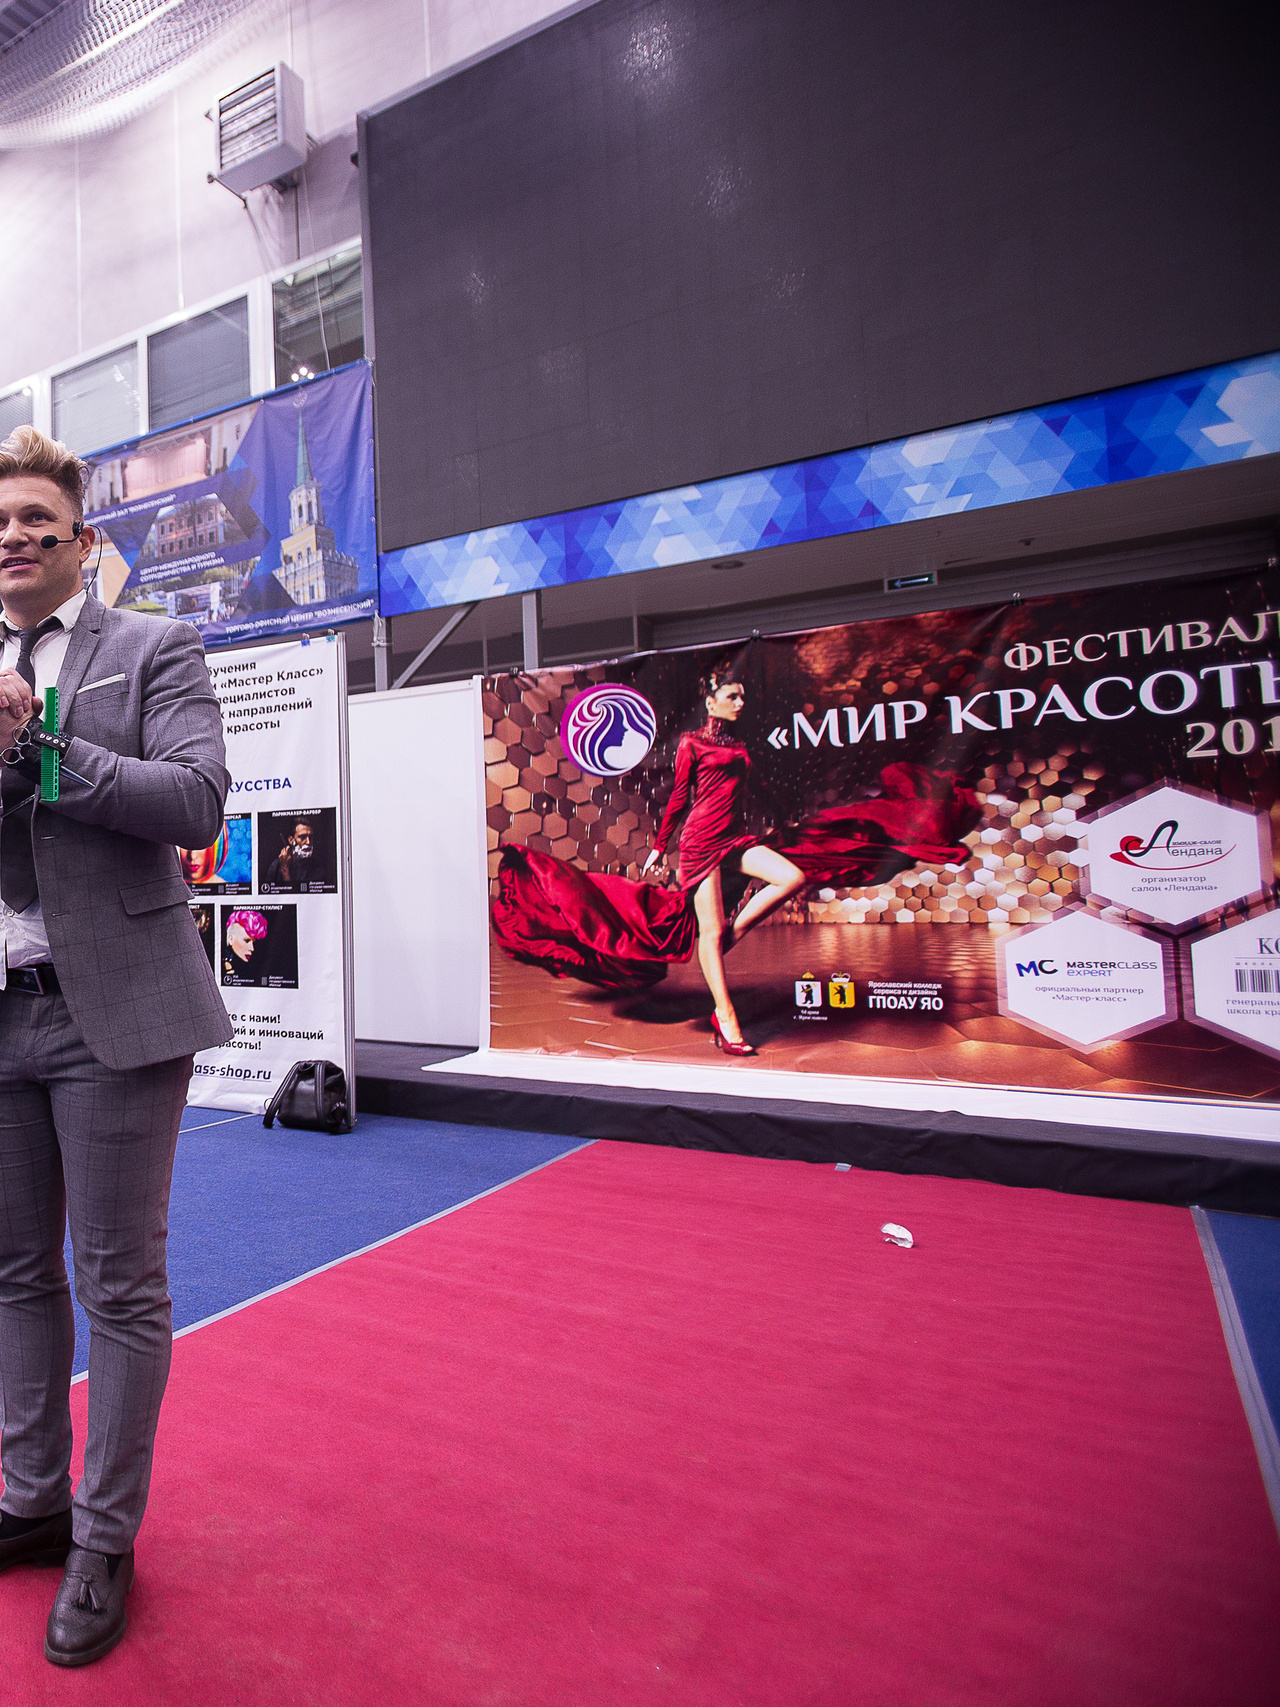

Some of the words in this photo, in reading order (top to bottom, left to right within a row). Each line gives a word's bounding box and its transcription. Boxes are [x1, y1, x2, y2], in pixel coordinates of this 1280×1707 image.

[290, 611, 314, 624] ЦЕНТР
[1004, 610, 1280, 671] ФЕСТИВАЛ
[221, 675, 273, 689] «Мастер
[277, 667, 323, 681] Класс»
[228, 697, 313, 719] направлений
[227, 719, 281, 735] красоты
[767, 700, 927, 750] «МИР
[1186, 716, 1280, 758] 201
[1141, 876, 1207, 884] организатор
[1164, 884, 1218, 892] «Лендана»
[1103, 987, 1144, 995] партнер
[868, 995, 917, 1010] ГПОАУ
[920, 997, 944, 1011] ЯО
[240, 1014, 246, 1022] с
[249, 1014, 281, 1023] нами!
[249, 1028, 256, 1036] и
[258, 1029, 324, 1041] инноваций
[194, 1064, 272, 1081] ass-shop.ru
